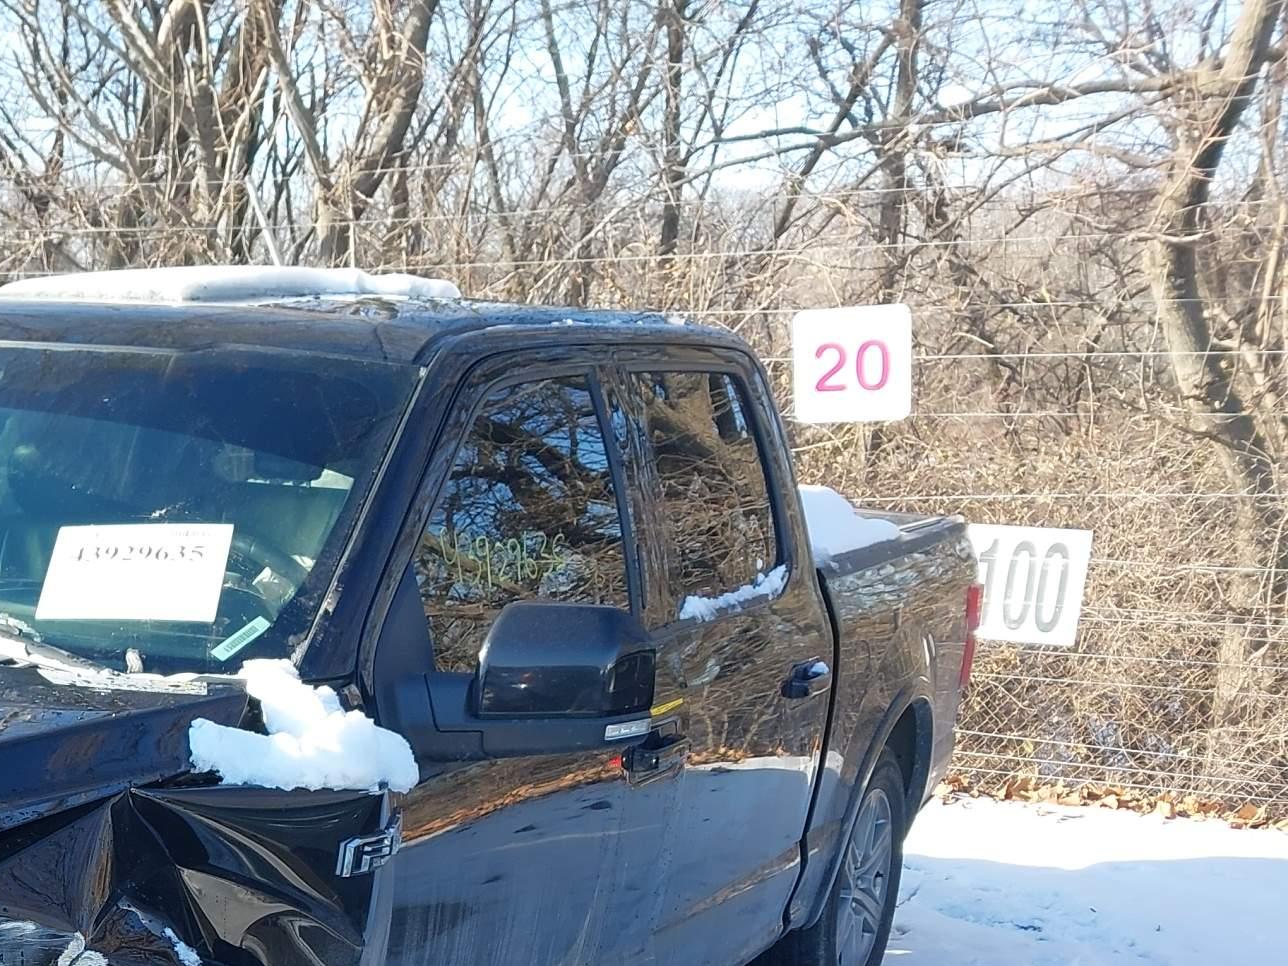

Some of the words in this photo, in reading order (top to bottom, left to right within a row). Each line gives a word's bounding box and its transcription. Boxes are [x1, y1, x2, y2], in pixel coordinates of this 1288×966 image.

[814, 338, 891, 393] 20
[72, 544, 207, 563] 43929635
[978, 537, 1071, 634] 100
